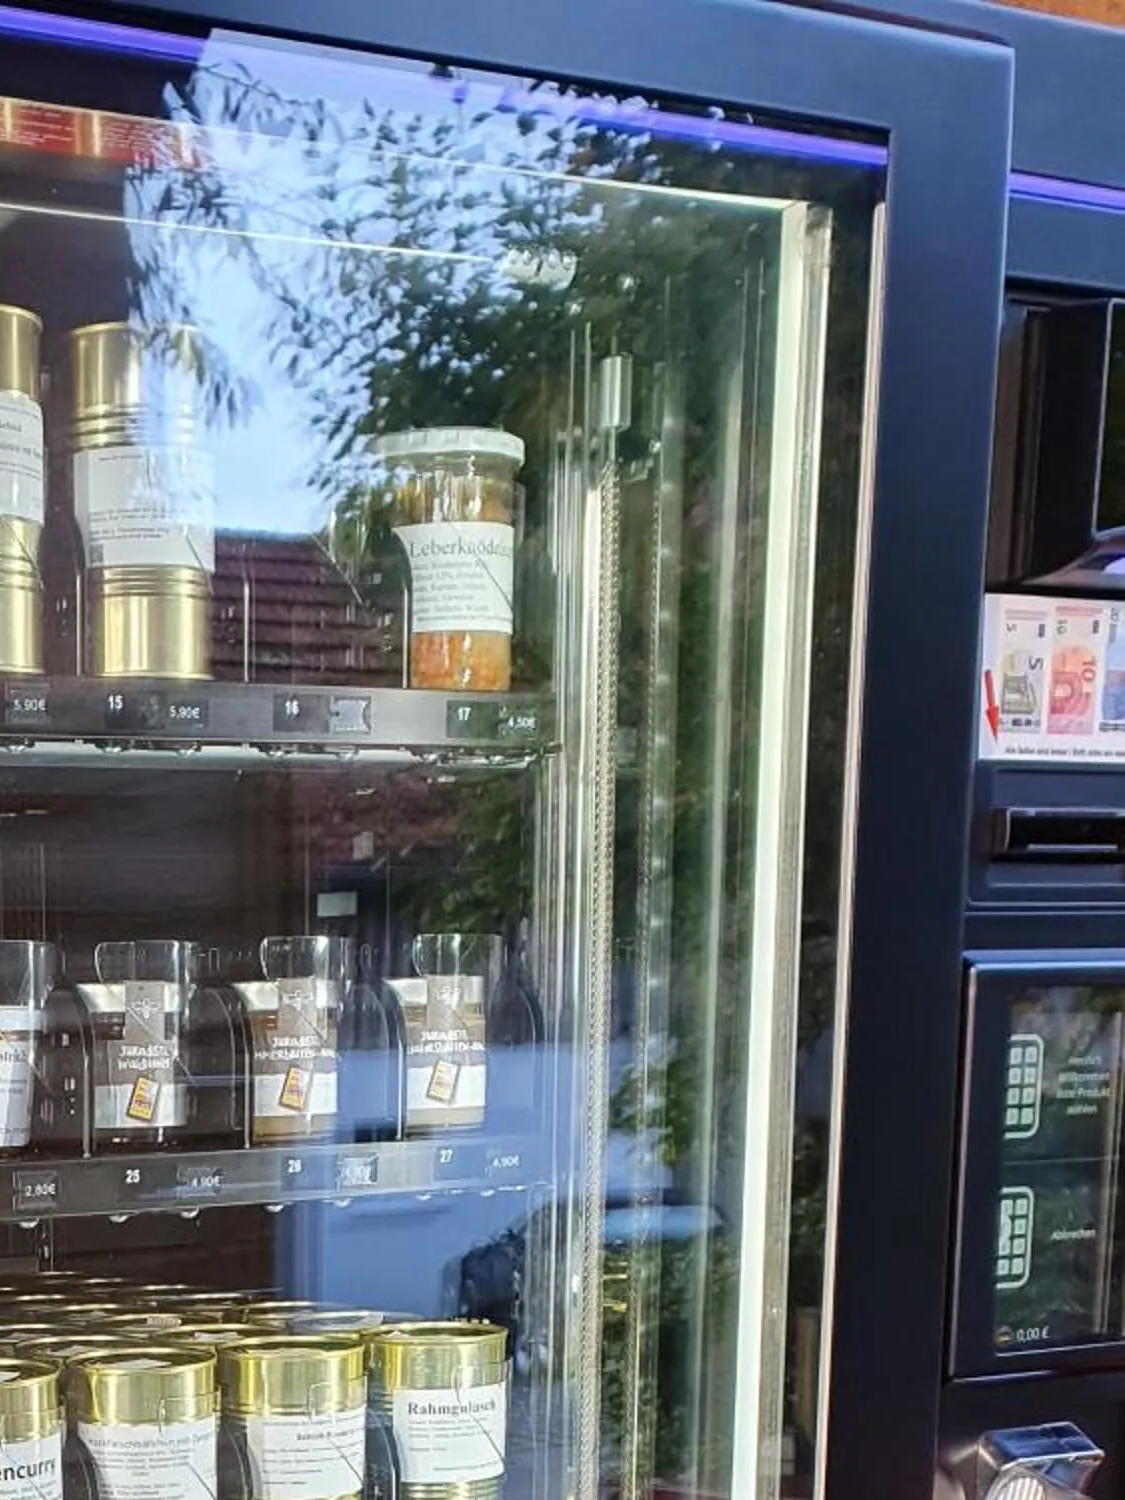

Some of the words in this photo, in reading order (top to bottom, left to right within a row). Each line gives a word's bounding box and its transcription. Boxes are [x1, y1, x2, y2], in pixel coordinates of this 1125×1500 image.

[109, 695, 123, 710] 15
[285, 700, 299, 715] 16
[457, 707, 471, 721] 17
[440, 1149, 453, 1163] 27
[126, 1169, 140, 1183] 25
